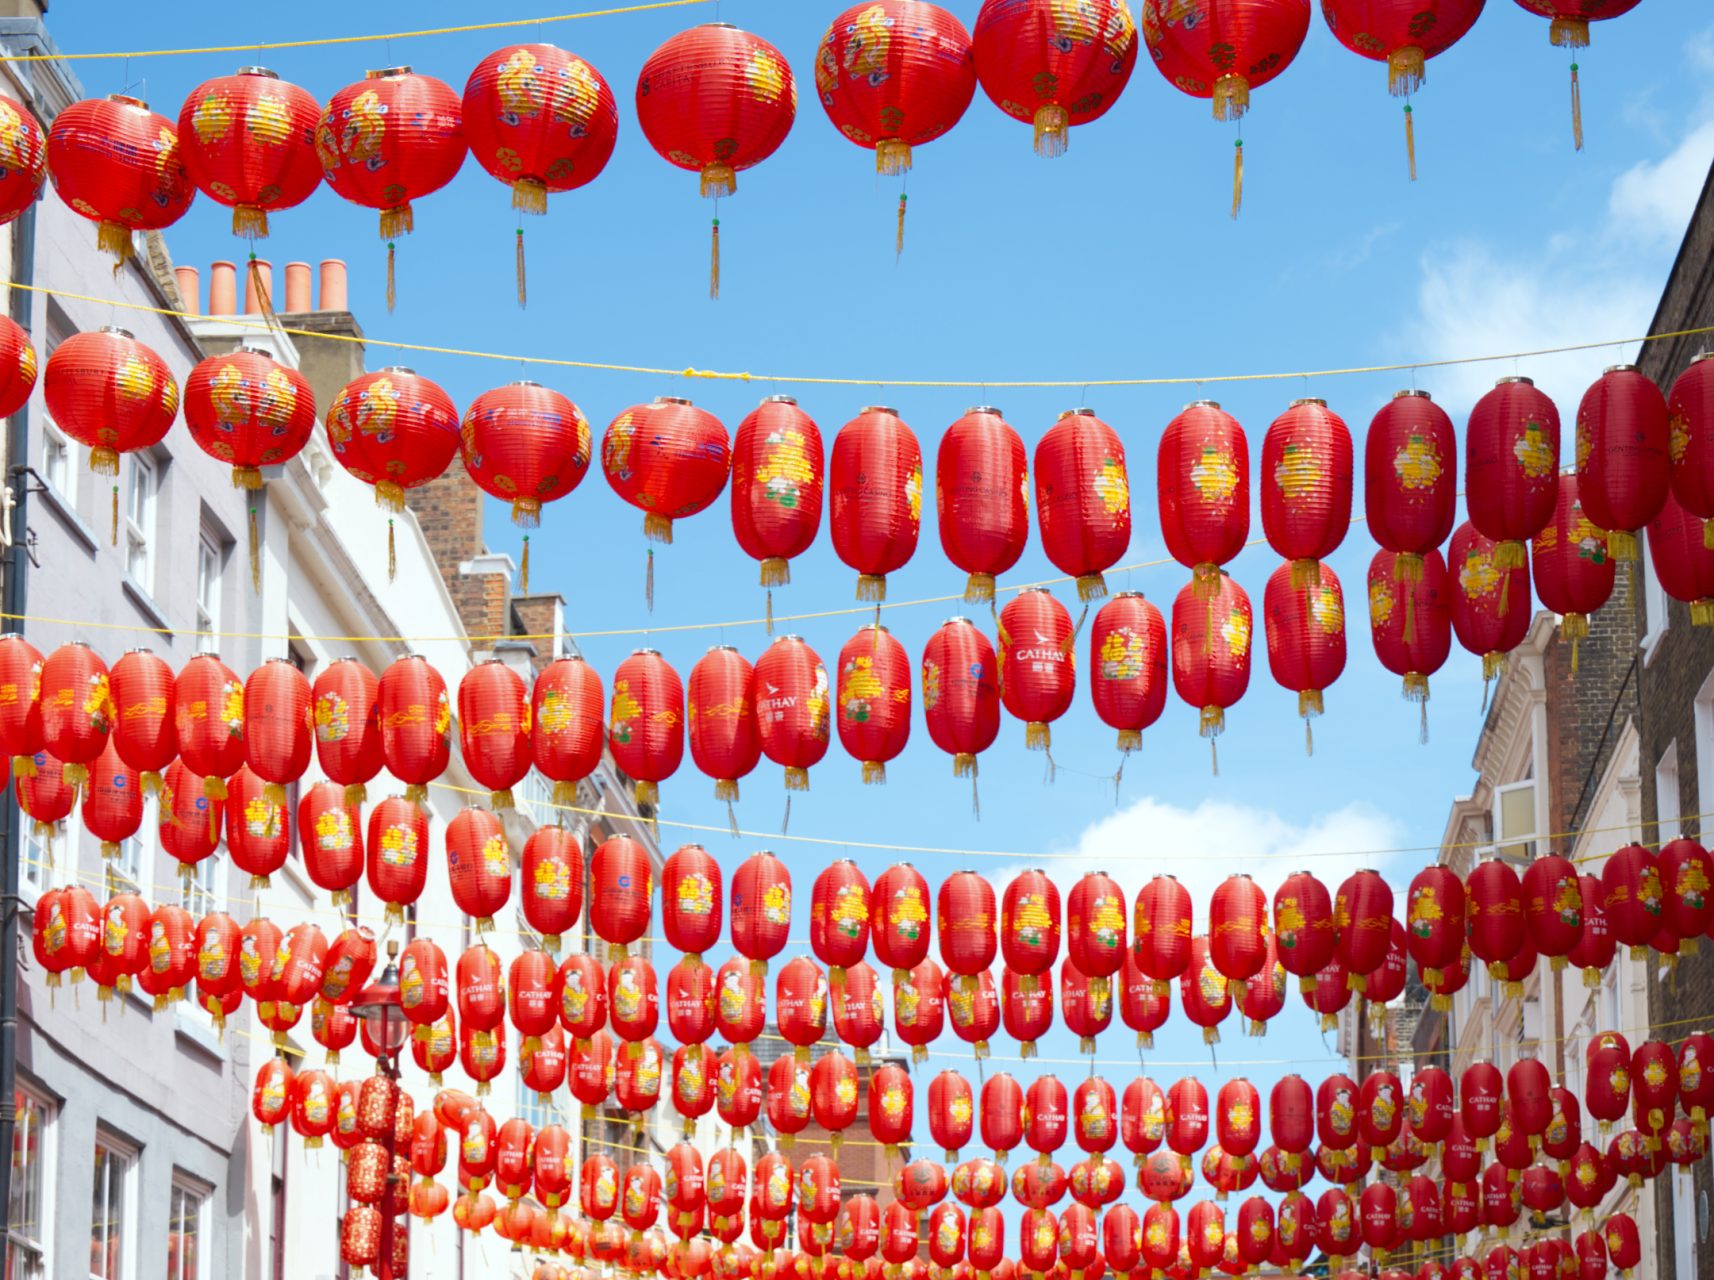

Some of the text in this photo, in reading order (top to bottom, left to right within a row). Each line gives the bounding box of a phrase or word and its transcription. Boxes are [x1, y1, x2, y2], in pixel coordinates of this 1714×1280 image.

[1016, 649, 1065, 662] CATHAY
[519, 990, 553, 999] CATHAY
[535, 1050, 565, 1060] CATHAY
[1469, 1096, 1498, 1105] CATHAY
